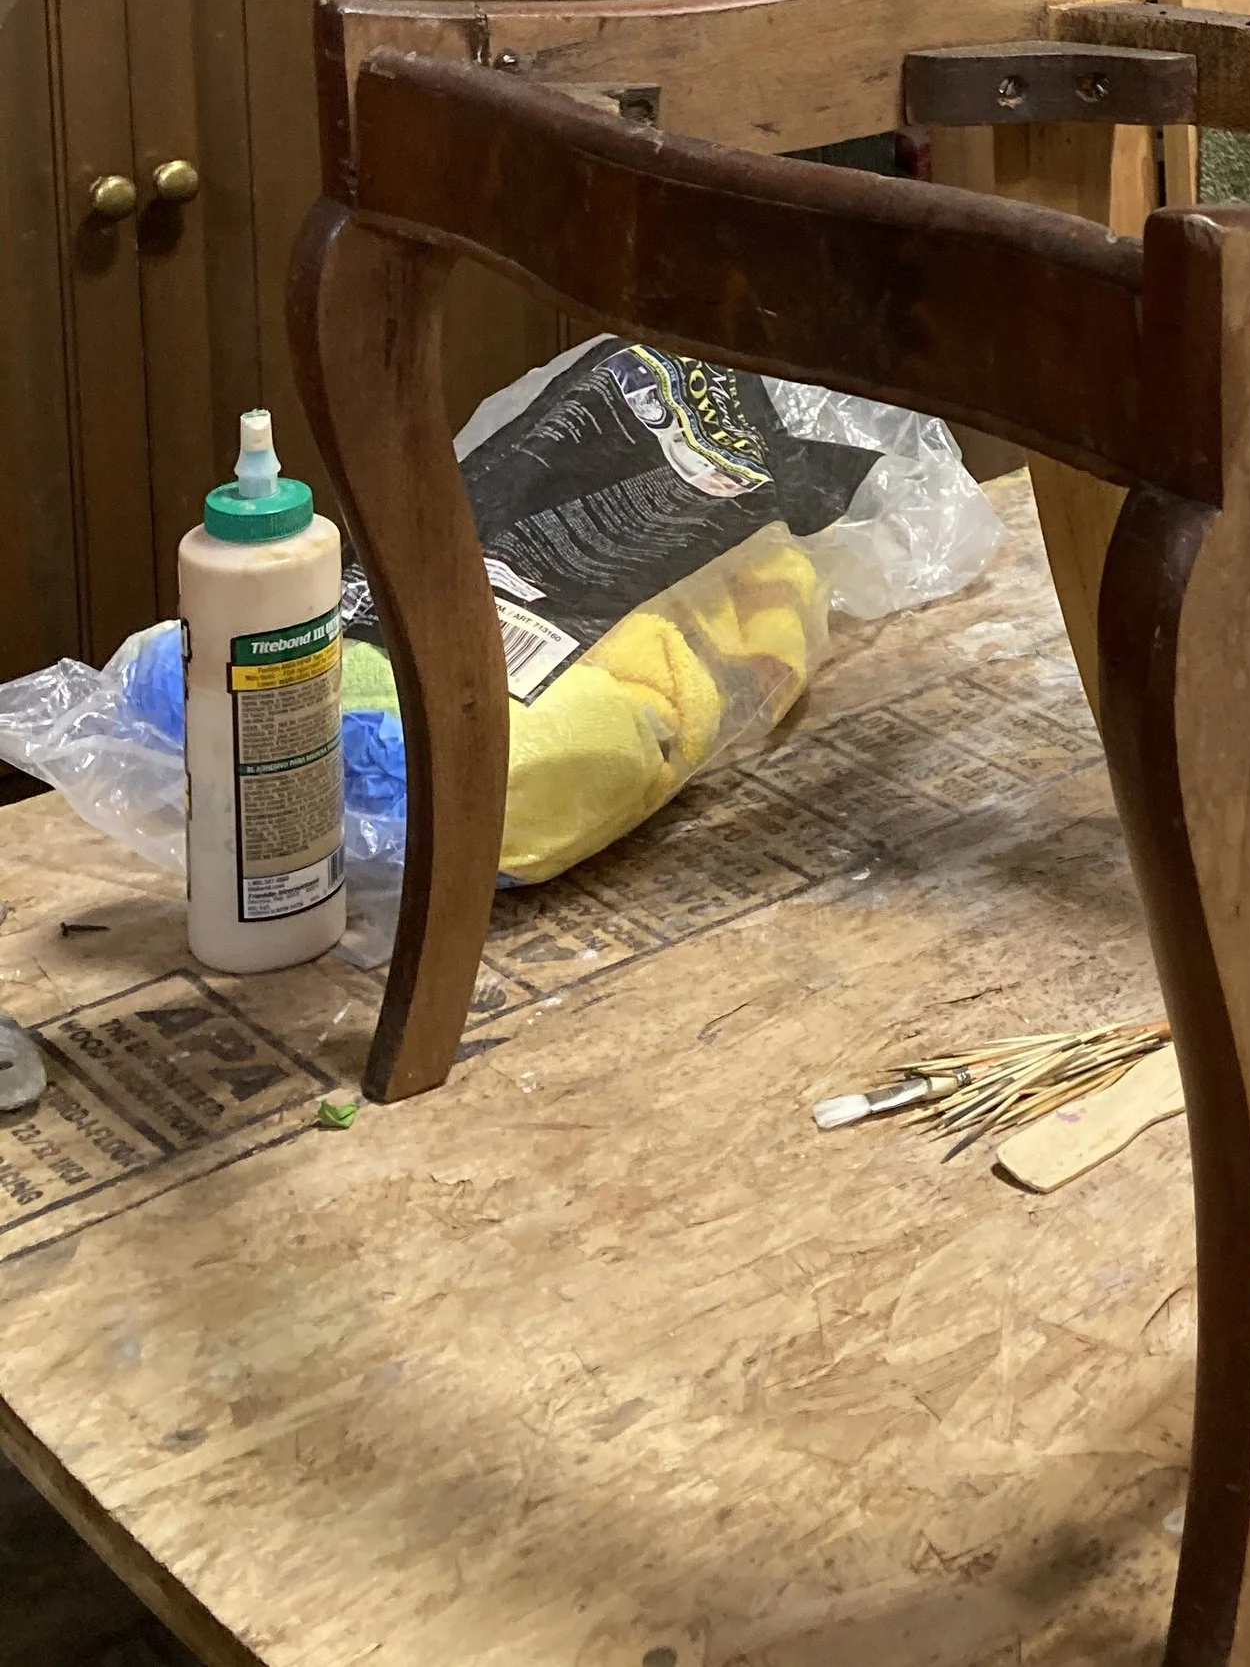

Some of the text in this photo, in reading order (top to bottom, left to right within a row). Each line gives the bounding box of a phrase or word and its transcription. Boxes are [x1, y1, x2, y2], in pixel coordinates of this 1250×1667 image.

[251, 631, 311, 654] Titebond
[313, 625, 325, 641] III
[532, 621, 562, 643] 713160
[134, 1006, 291, 1102] APA
